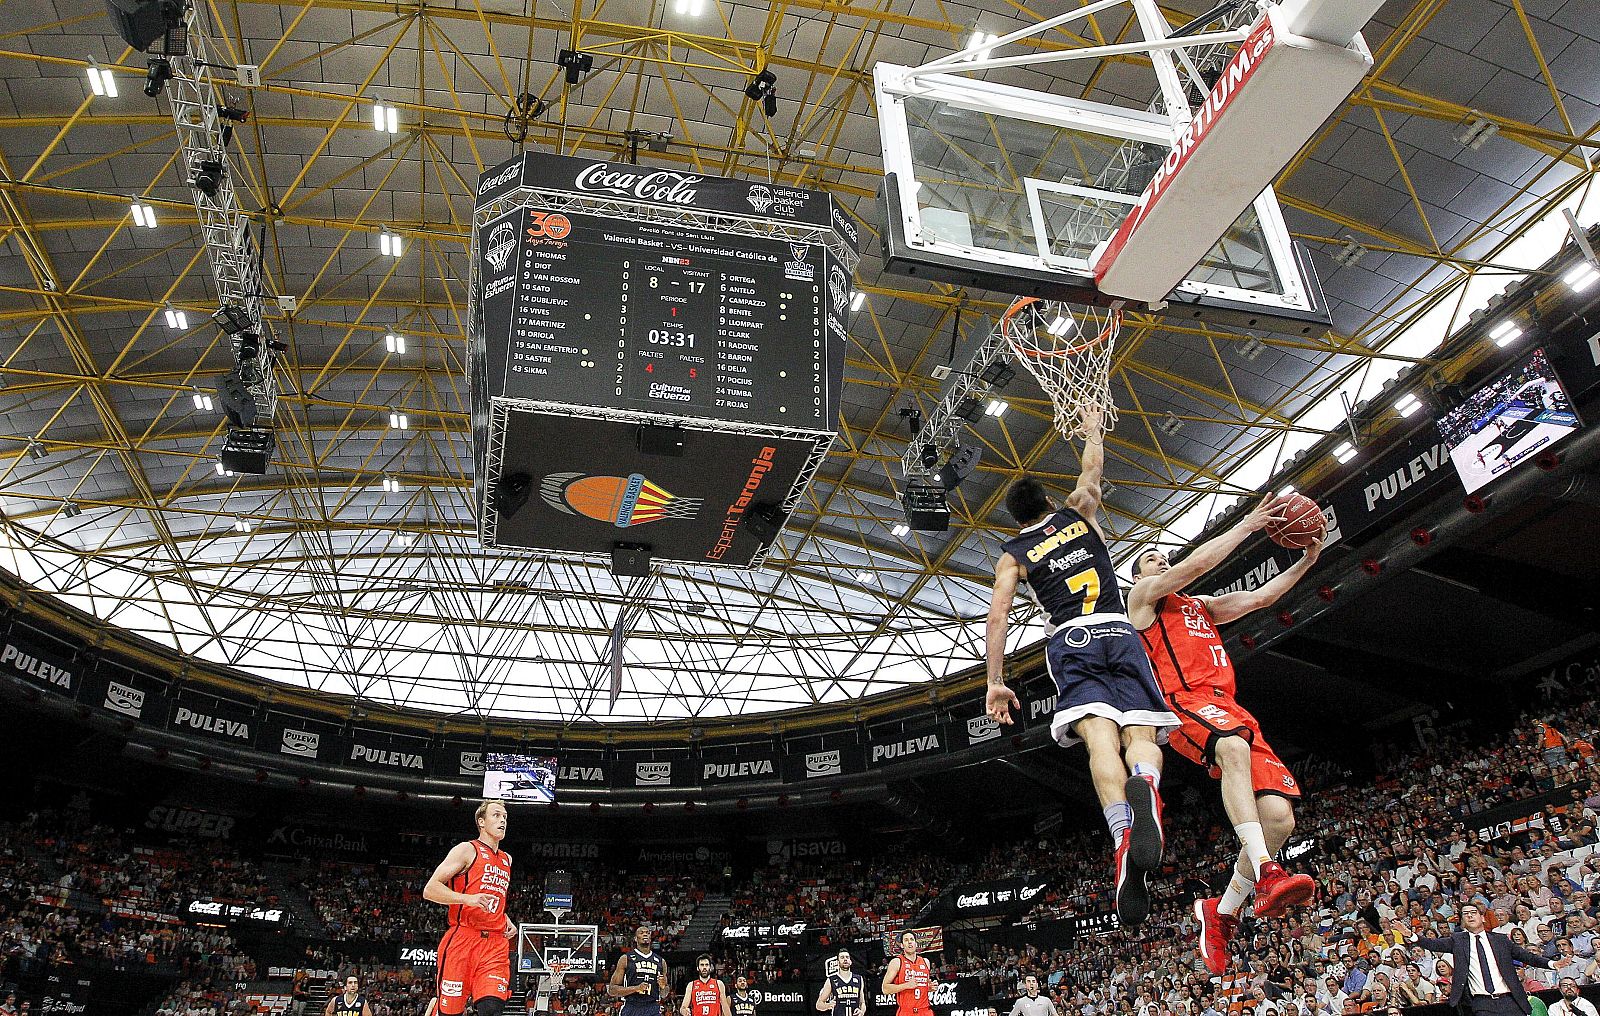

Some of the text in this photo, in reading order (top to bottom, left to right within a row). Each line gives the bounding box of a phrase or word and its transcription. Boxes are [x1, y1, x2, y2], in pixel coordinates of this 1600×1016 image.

[1133, 26, 1275, 222] SPORTIUM.es
[479, 161, 523, 196] Coca-Cola
[574, 162, 703, 206] Coca-Cola
[773, 188, 810, 200] valencia
[773, 195, 804, 208] basket
[774, 204, 795, 214] club
[833, 208, 857, 243] Coca-Cola
[603, 234, 778, 262] Valencia Basket Universidad Católica de
[525, 249, 567, 260] 0 THOMAS
[524, 260, 532, 268] 8
[623, 261, 630, 269] 0
[644, 265, 665, 273] LOCAL
[523, 271, 581, 285] 9 VAN ROSSOM
[622, 271, 629, 280] 0
[683, 269, 711, 278] VISITANT
[720, 273, 756, 284] 5 ORTEGA
[486, 276, 509, 291] Cultura
[622, 282, 629, 291] 0
[649, 276, 659, 288] 8
[688, 281, 706, 294] 17
[485, 280, 515, 299] Esfuerzo
[532, 284, 551, 293] SATO
[720, 284, 755, 295] 6 ANTELO
[813, 285, 819, 293] 0
[520, 294, 569, 306] 14 DUBLJEVIC
[621, 293, 628, 302] 0
[720, 295, 766, 307] 7 CAMPAZZO
[813, 296, 819, 304] 0
[530, 307, 550, 316] VIVES
[620, 305, 627, 313] 3
[671, 307, 677, 317] 1
[719, 306, 752, 317] 8 BENITE
[813, 306, 819, 315] 3
[518, 317, 566, 329] 17 MARTINEZ
[620, 316, 627, 324] 0
[719, 317, 764, 329] 9 LLOMPART
[813, 317, 820, 326] 8
[516, 329, 555, 340] 18 ORIOLA
[620, 328, 625, 336] 1
[728, 330, 750, 339] CLARK
[813, 328, 820, 336] 0
[618, 340, 625, 348] 0
[648, 329, 696, 348] 03:31
[813, 340, 820, 348] 0
[515, 341, 579, 354] 19 SAN EMETERIO
[717, 340, 759, 351] 11 RADOVIC
[525, 354, 552, 364] SASTRE
[617, 351, 624, 360] 0
[638, 350, 664, 359] FALTES
[680, 355, 705, 364] FALTES
[717, 351, 752, 362] 12 BARON
[813, 351, 820, 359] 2
[524, 366, 548, 375] SIKMA
[616, 363, 623, 372] 2
[645, 363, 654, 373] 4
[717, 363, 747, 373] 16 DELIA
[813, 362, 820, 371] 0
[689, 368, 698, 379] 5
[813, 373, 820, 382] 2
[616, 375, 623, 384] 2
[716, 375, 753, 386] 17 POCIUS
[615, 387, 622, 396] 0
[650, 382, 684, 394] Cultura
[715, 387, 752, 398] 24 TUMBA
[813, 385, 820, 394] 0
[648, 389, 691, 402] Esfuerzo
[813, 397, 820, 405] 0
[715, 399, 749, 409] 27 ROJAS
[813, 408, 820, 417] 2
[618, 476, 642, 525] VALENCIA BASKET
[705, 446, 777, 561] Esperit Taronja
[1026, 520, 1089, 563] CAMPAZZO
[1064, 567, 1101, 615] 7
[1208, 645, 1228, 667] 17
[1, 643, 71, 689] PULEVA
[109, 684, 143, 703] PULEVA
[174, 707, 249, 739] PULEVA
[284, 731, 318, 746] PULEVA
[872, 734, 940, 763] PULEVA
[351, 744, 424, 770] PULEVA
[462, 752, 483, 763] PUL
[808, 753, 840, 766] PULEVA
[638, 764, 670, 775] PULEVA
[703, 760, 773, 780] PULEVA
[144, 806, 236, 839] SUPER
[290, 828, 368, 853] CaixaBank
[635, 961, 658, 971] UCAM
[836, 986, 859, 994] UCAM
[914, 988, 921, 999] 9
[764, 992, 803, 1002] Bertolín
[735, 1003, 754, 1012] UCAM
